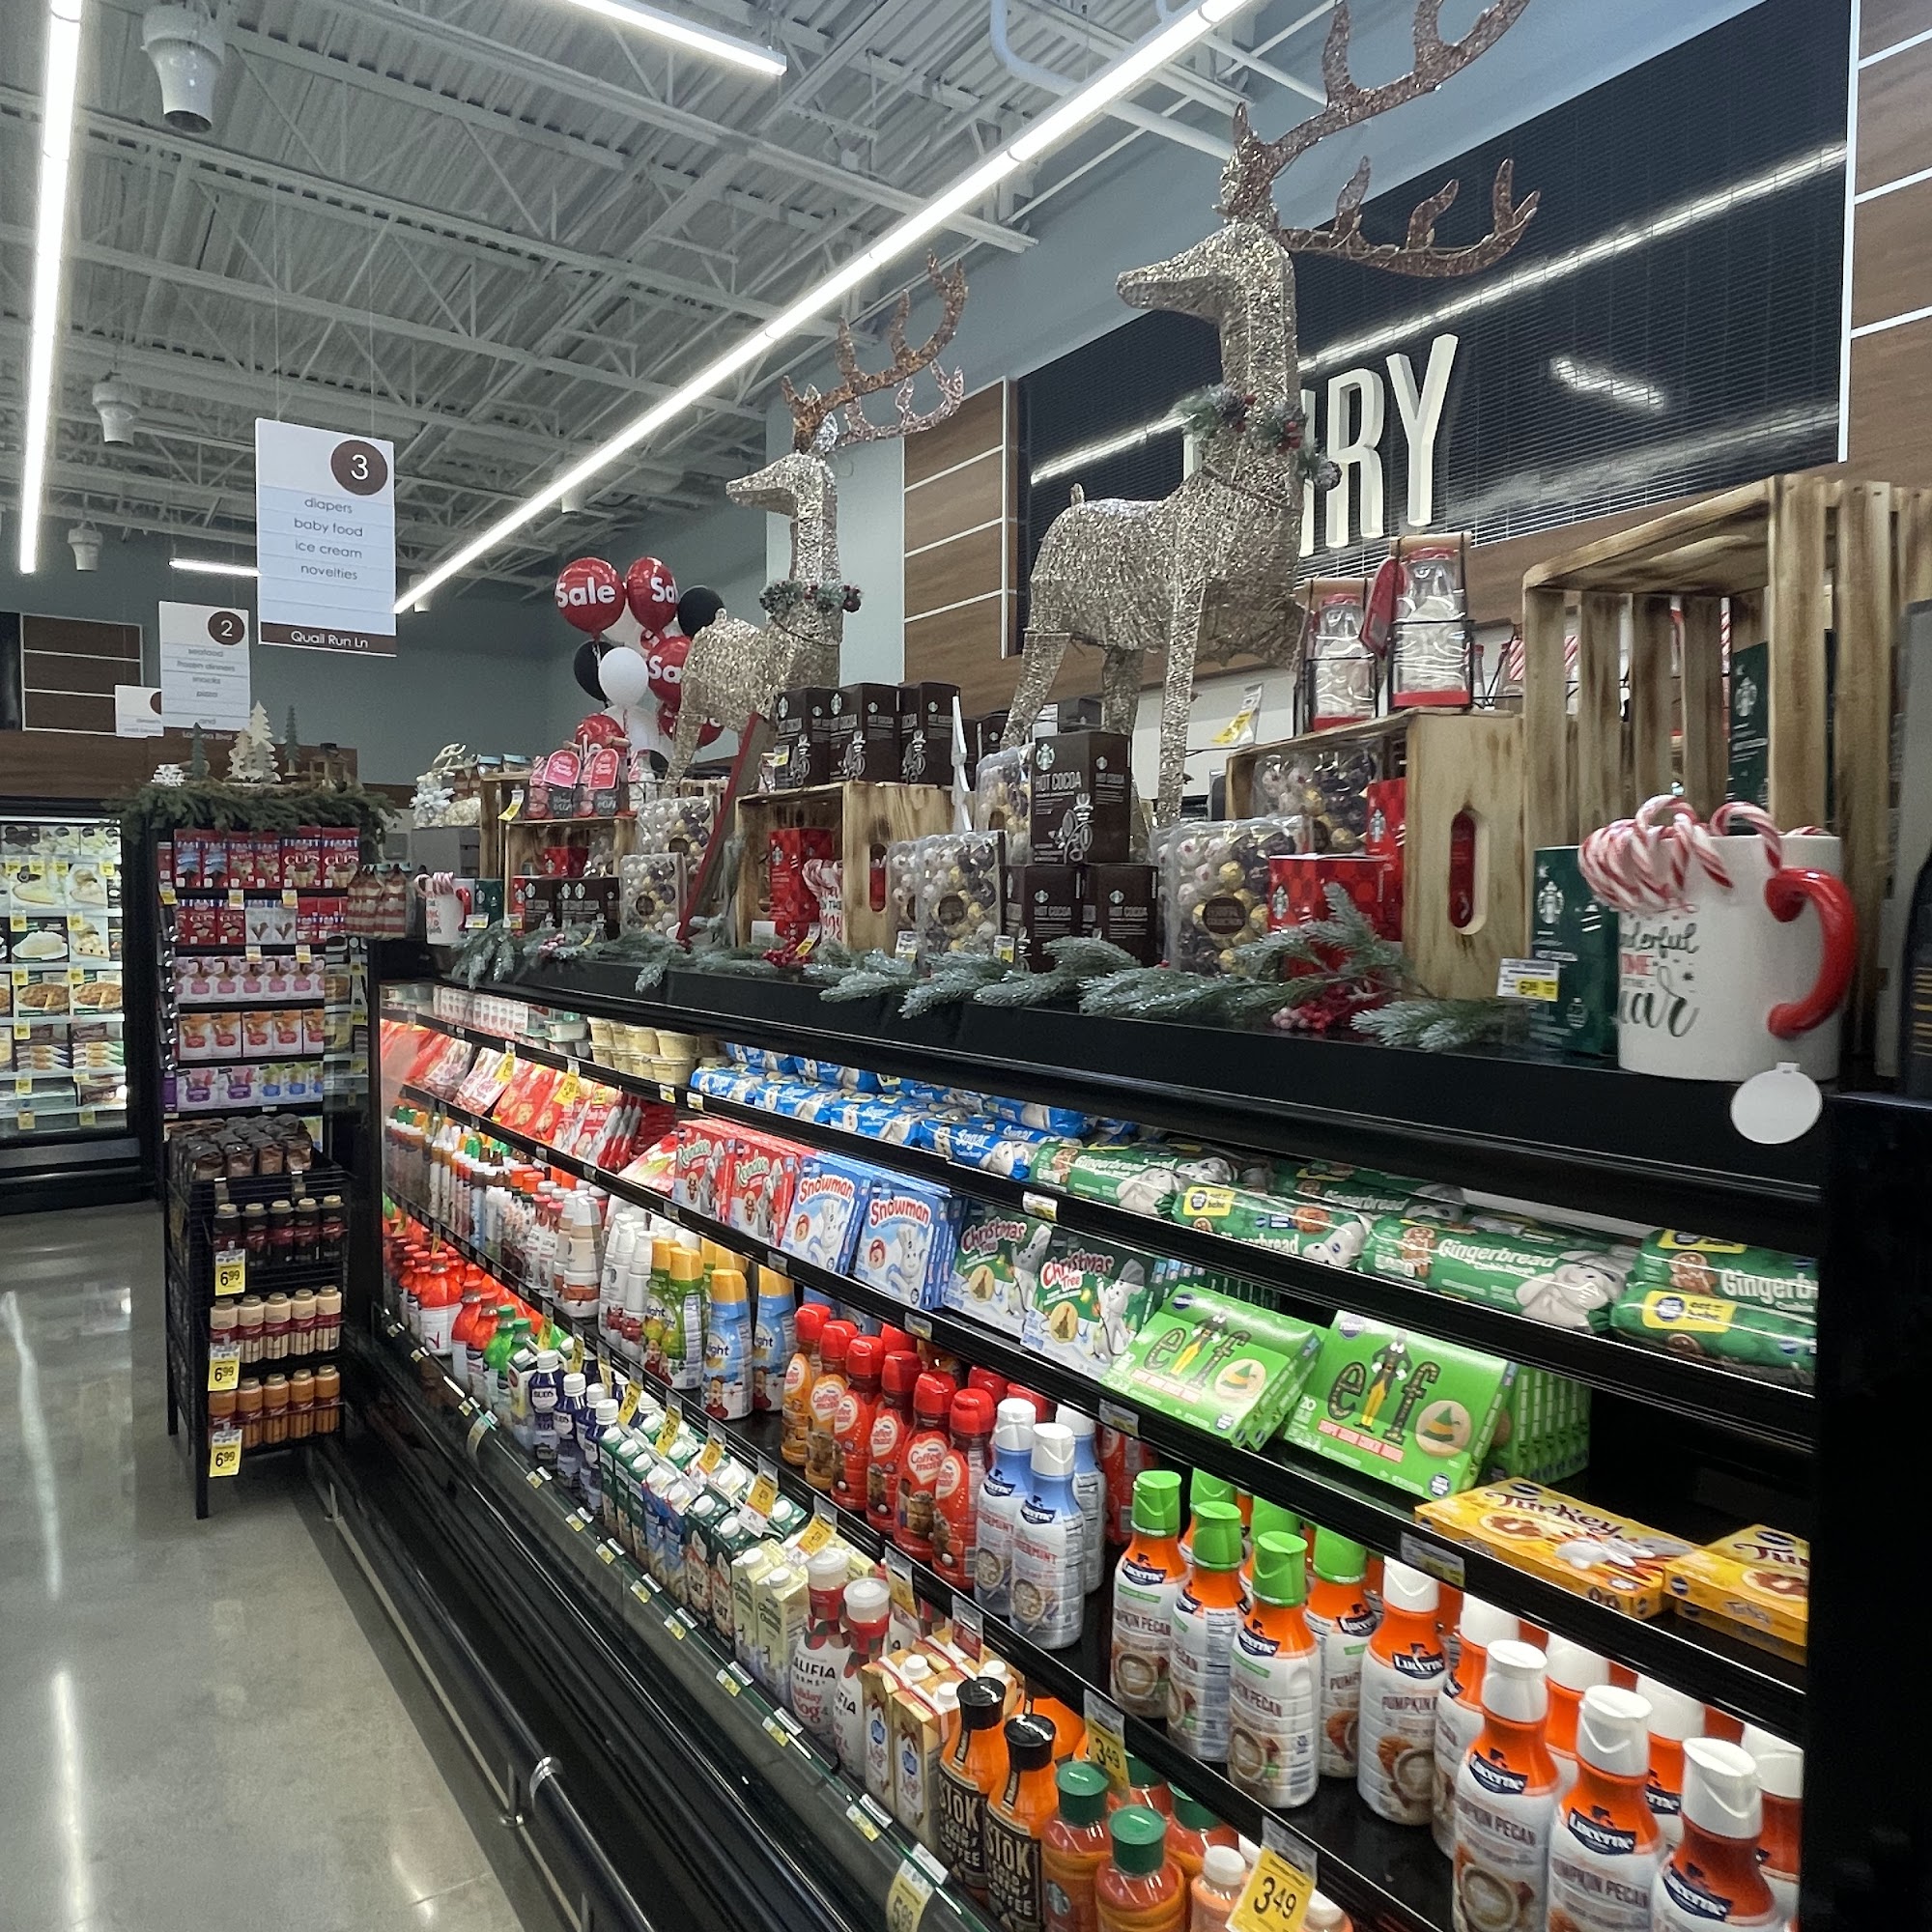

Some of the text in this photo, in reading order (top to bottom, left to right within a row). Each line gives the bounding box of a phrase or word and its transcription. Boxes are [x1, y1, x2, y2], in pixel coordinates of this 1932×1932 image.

[351, 454, 369, 480] 3
[304, 497, 353, 514] diapers
[294, 518, 363, 537] baby food
[295, 539, 363, 559] ice cream
[300, 563, 358, 581] novelties
[554, 577, 615, 608] Sale
[220, 619, 233, 638] 2
[290, 630, 369, 648] Quail Run Ln
[1051, 771, 1082, 790] COCOA
[956, 1128, 991, 1151] Sugar
[798, 1174, 855, 1205] Snowman
[869, 1196, 931, 1228] Snowman
[961, 1216, 1027, 1254] Christmas
[979, 1240, 998, 1256] Tree
[1438, 1238, 1559, 1268] Gingerbread
[220, 1269, 241, 1287] 699
[1040, 1248, 1115, 1290] Christmas
[1062, 1273, 1082, 1292] Tree
[214, 1366, 234, 1382] 699
[812, 1391, 839, 1403] Coffee
[215, 1452, 236, 1467] 699
[911, 1450, 941, 1464] Coffee
[1485, 1492, 1624, 1536] Turkey
[1141, 1616, 1172, 1636] PECAN
[793, 1656, 837, 1680] ALIFIA
[1394, 1654, 1444, 1672] Lucerne
[1251, 1690, 1283, 1719] PECAN
[1382, 1696, 1433, 1714] PUMPKIN
[1469, 1752, 1526, 1792] Lucerne
[1494, 1815, 1537, 1846] PECAN
[1569, 1811, 1635, 1851] Lucerne
[1254, 1876, 1297, 1920] 349
[1605, 1879, 1651, 1909] PECAN
